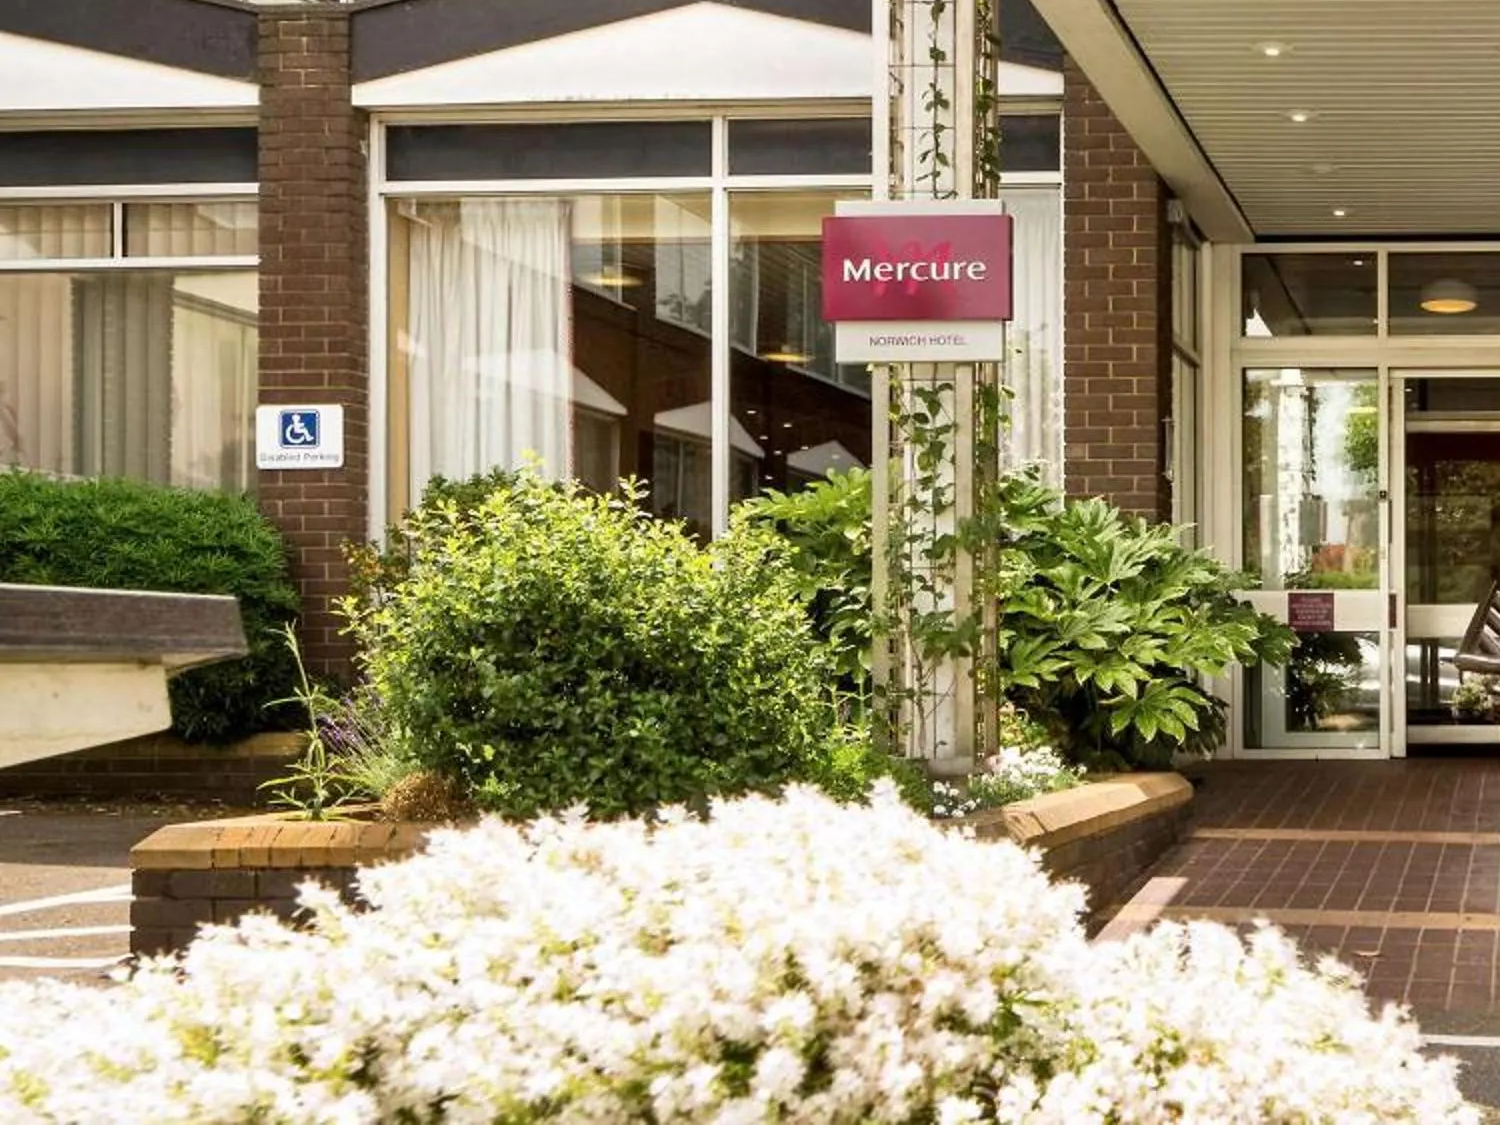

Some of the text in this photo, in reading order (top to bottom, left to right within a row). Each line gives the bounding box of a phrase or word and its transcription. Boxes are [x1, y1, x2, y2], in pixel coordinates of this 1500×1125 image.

[842, 258, 988, 282] Mercure
[869, 334, 968, 347] NORWICH HOTEL
